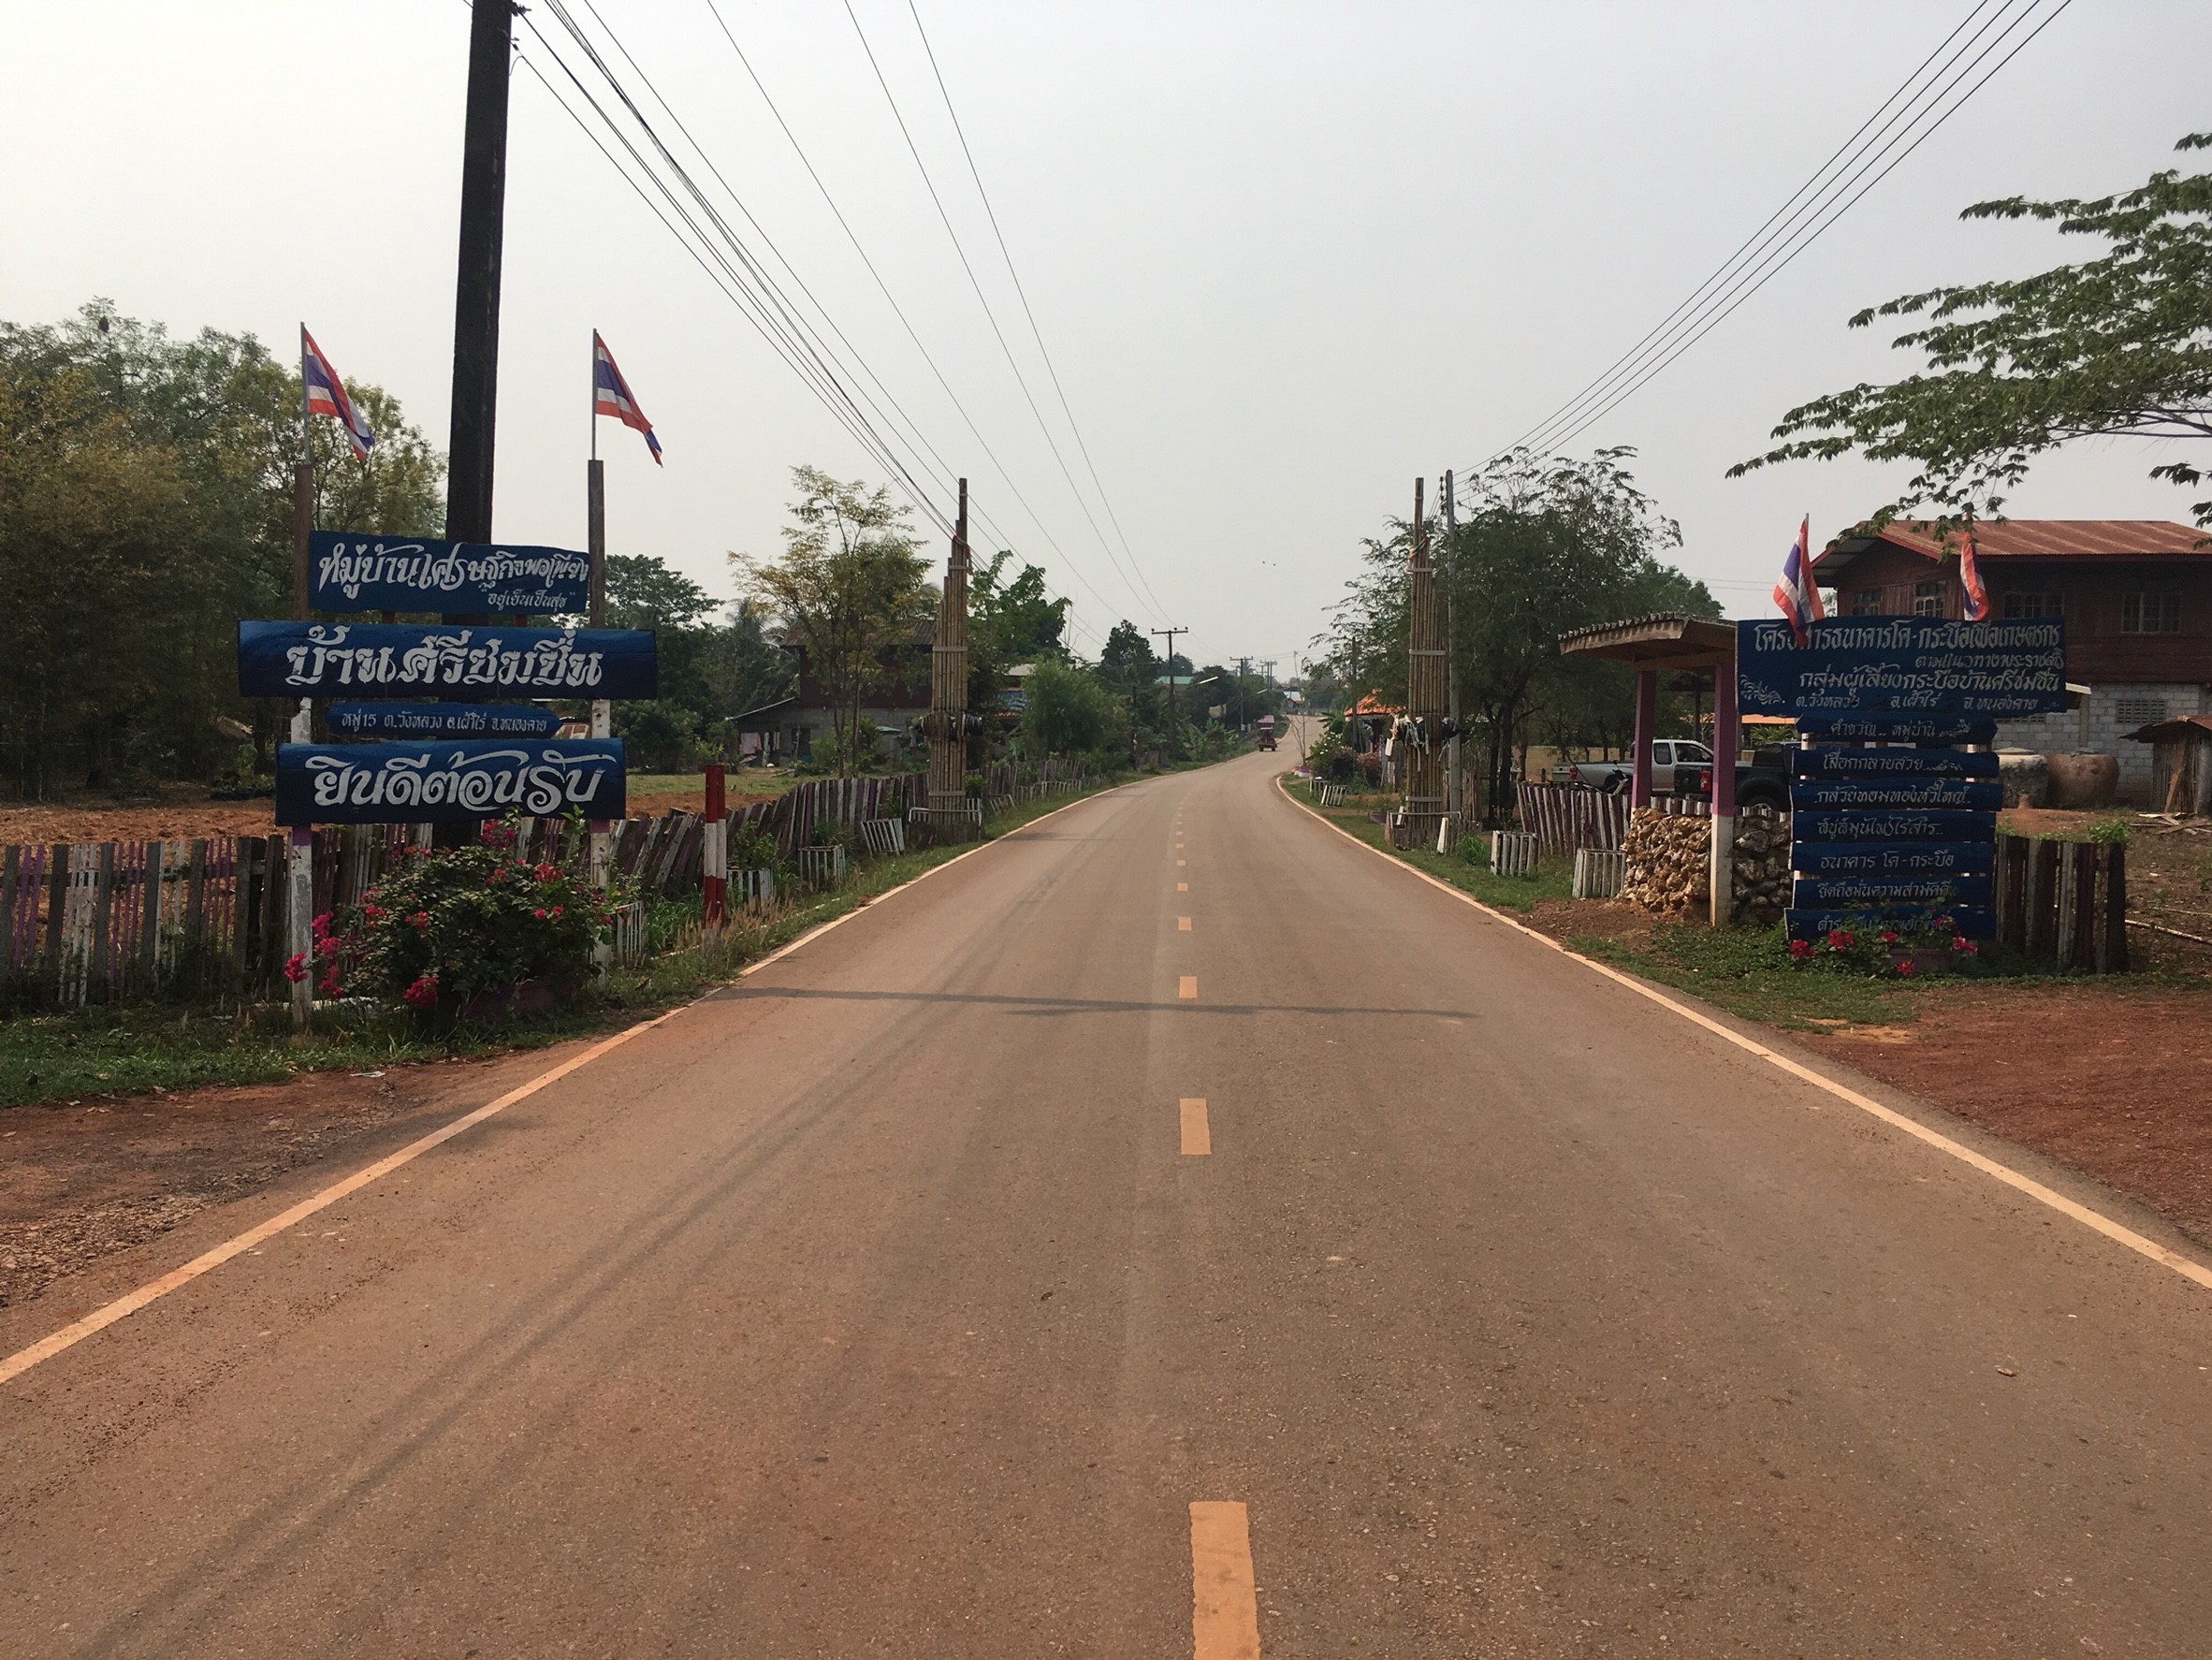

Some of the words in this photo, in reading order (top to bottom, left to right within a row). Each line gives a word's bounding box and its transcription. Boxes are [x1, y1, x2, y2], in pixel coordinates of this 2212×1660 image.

[284, 625, 605, 688] บ้านศรีชมชื่น
[305, 750, 617, 815] ยินดีต้อนรับ
[1820, 855, 1876, 869] ธนาคาร
